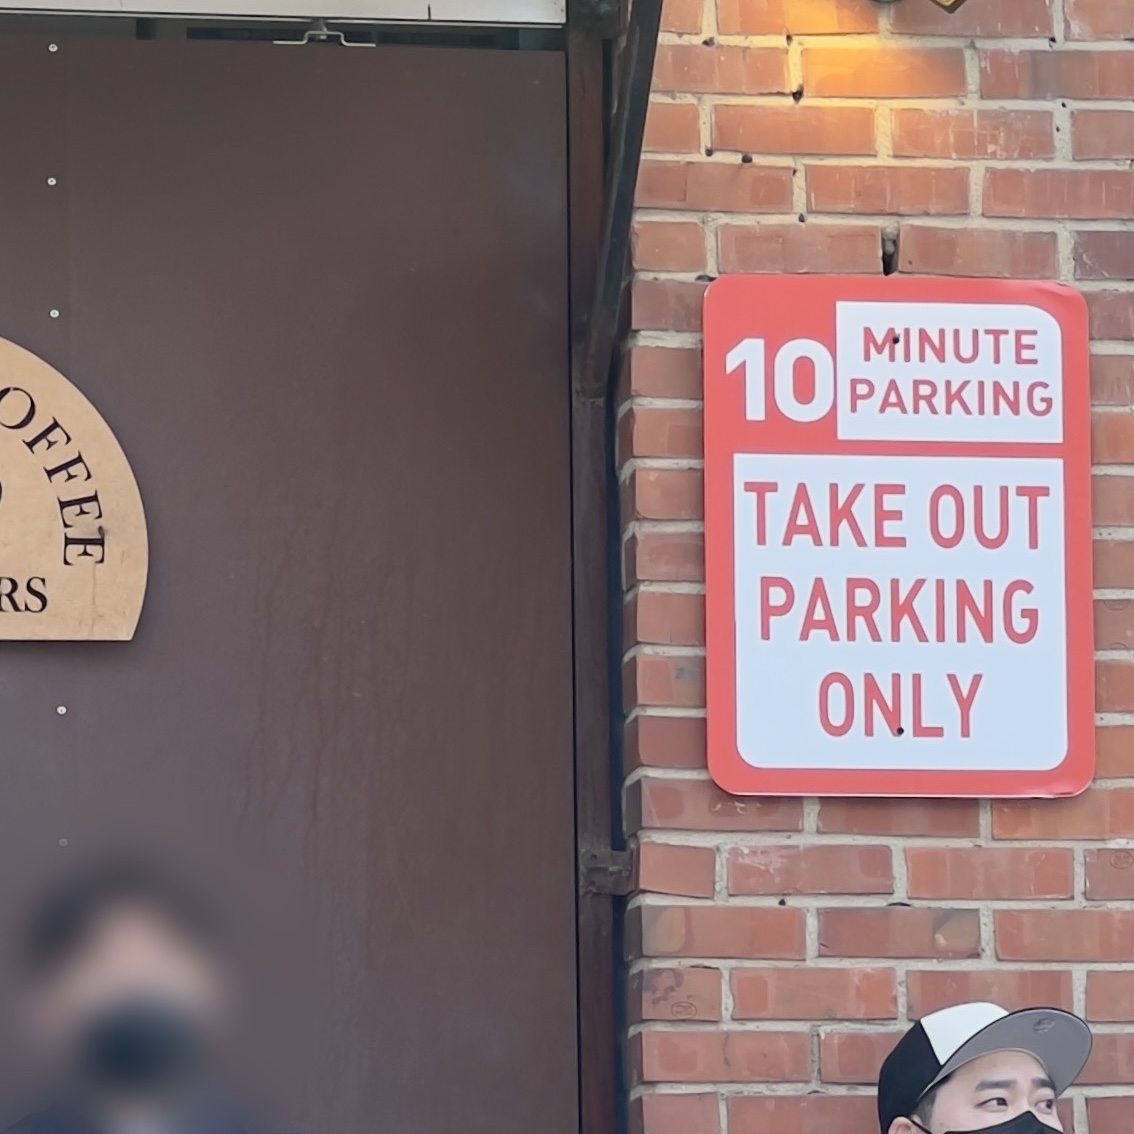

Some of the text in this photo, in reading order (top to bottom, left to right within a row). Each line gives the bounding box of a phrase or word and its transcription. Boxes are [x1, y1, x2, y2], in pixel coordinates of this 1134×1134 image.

[863, 326, 1039, 365] MINUTE
[725, 337, 835, 424] 10
[849, 378, 1055, 417] PARKING
[743, 481, 1051, 551] TAKE OUT
[759, 575, 1040, 645] PARKING
[817, 670, 984, 739] ONLY
